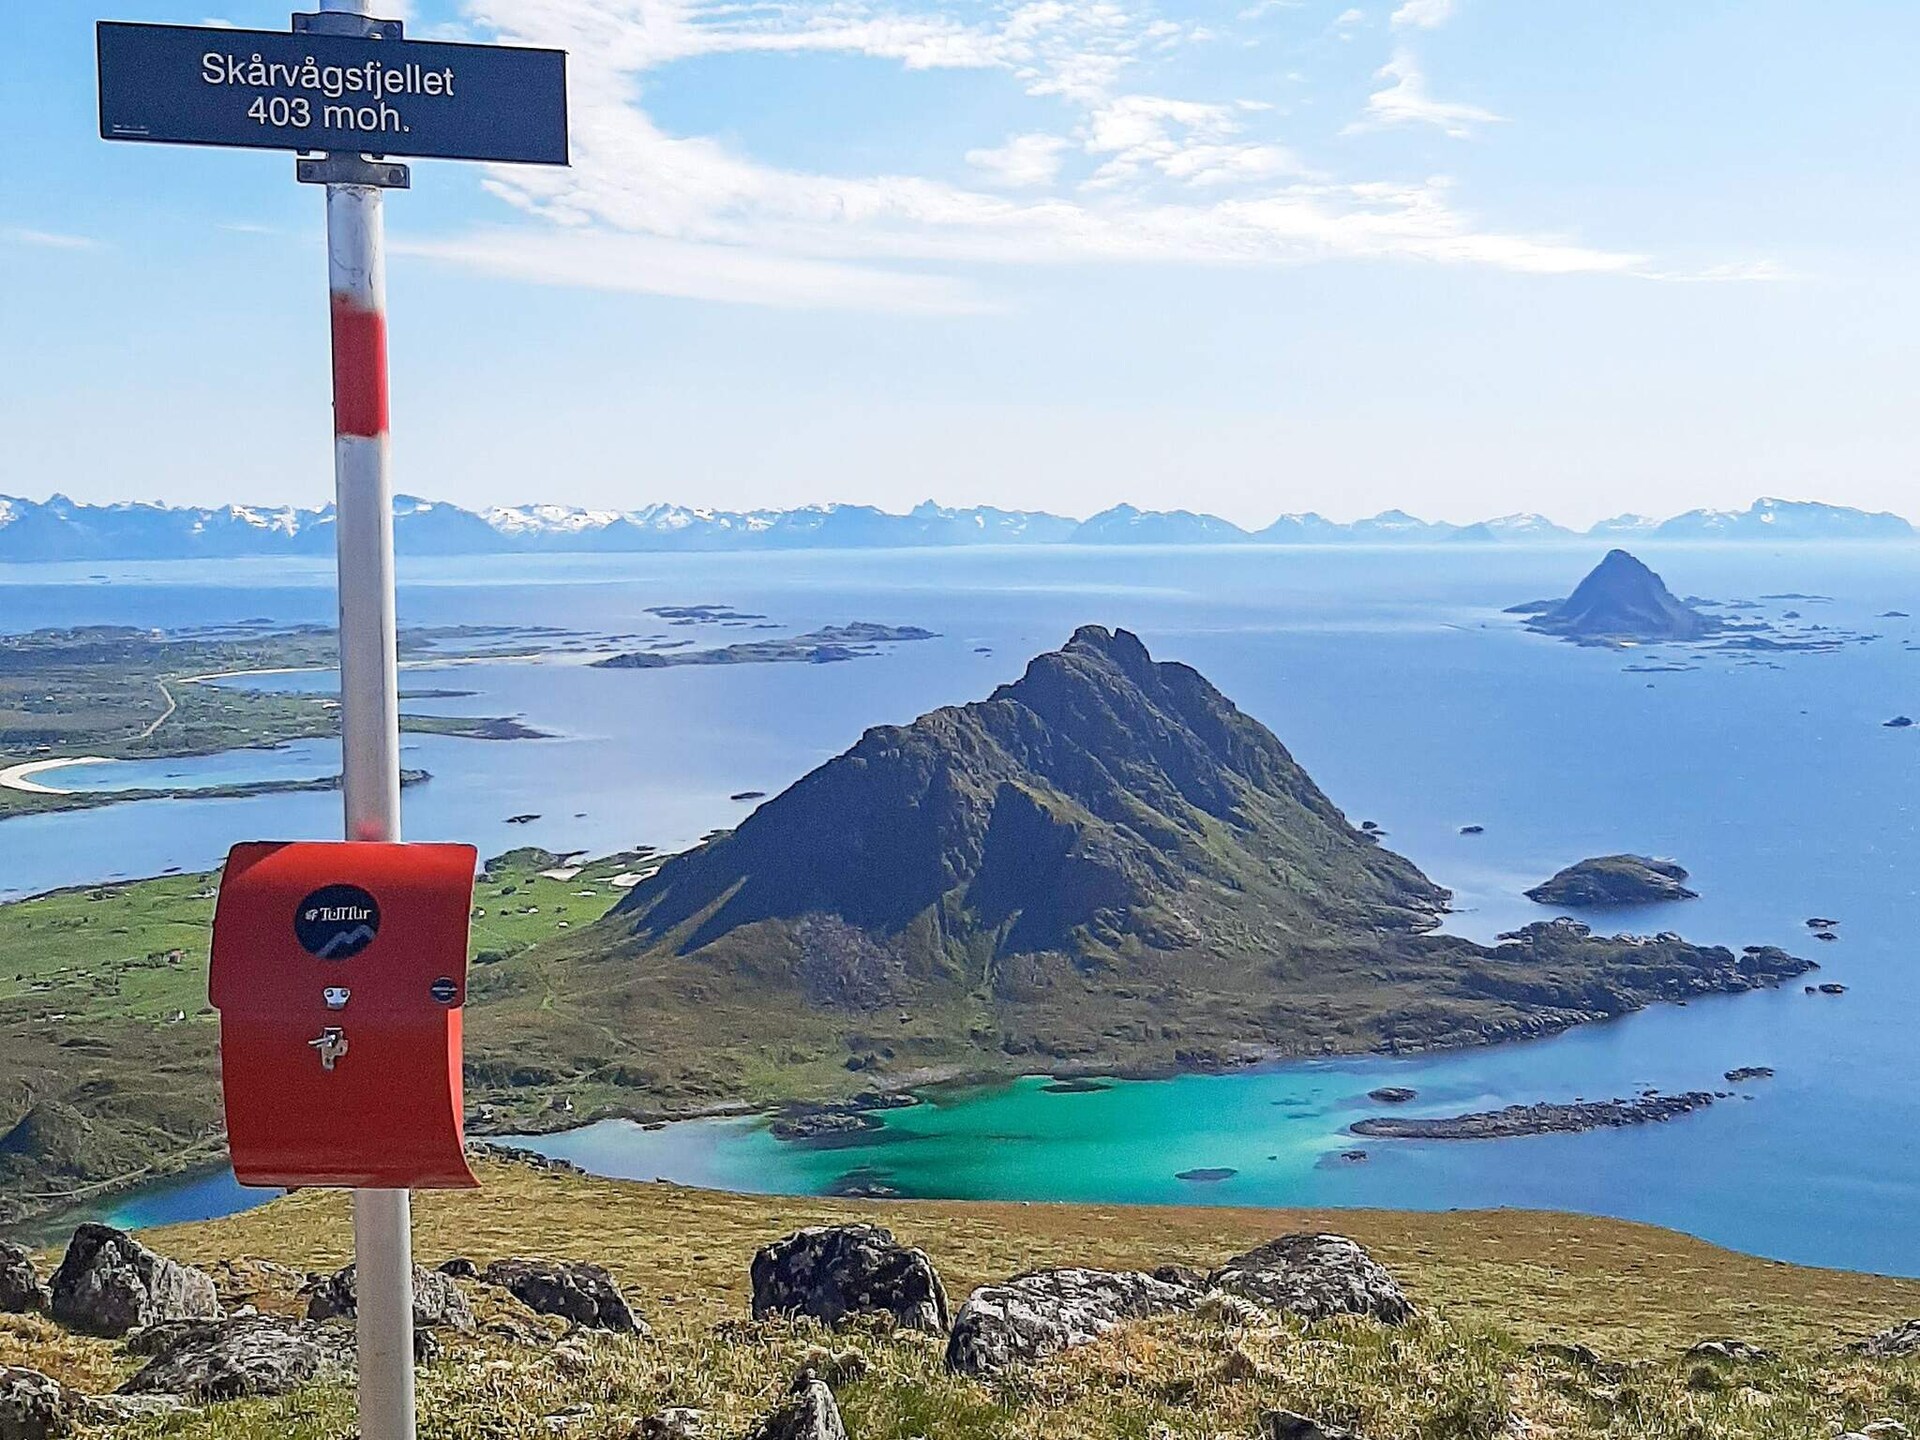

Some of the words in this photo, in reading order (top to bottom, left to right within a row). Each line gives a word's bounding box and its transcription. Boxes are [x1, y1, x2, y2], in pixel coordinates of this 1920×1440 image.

[201, 51, 455, 100] Skårvågsfjellet
[246, 95, 312, 128] 403
[322, 101, 411, 133] moh.
